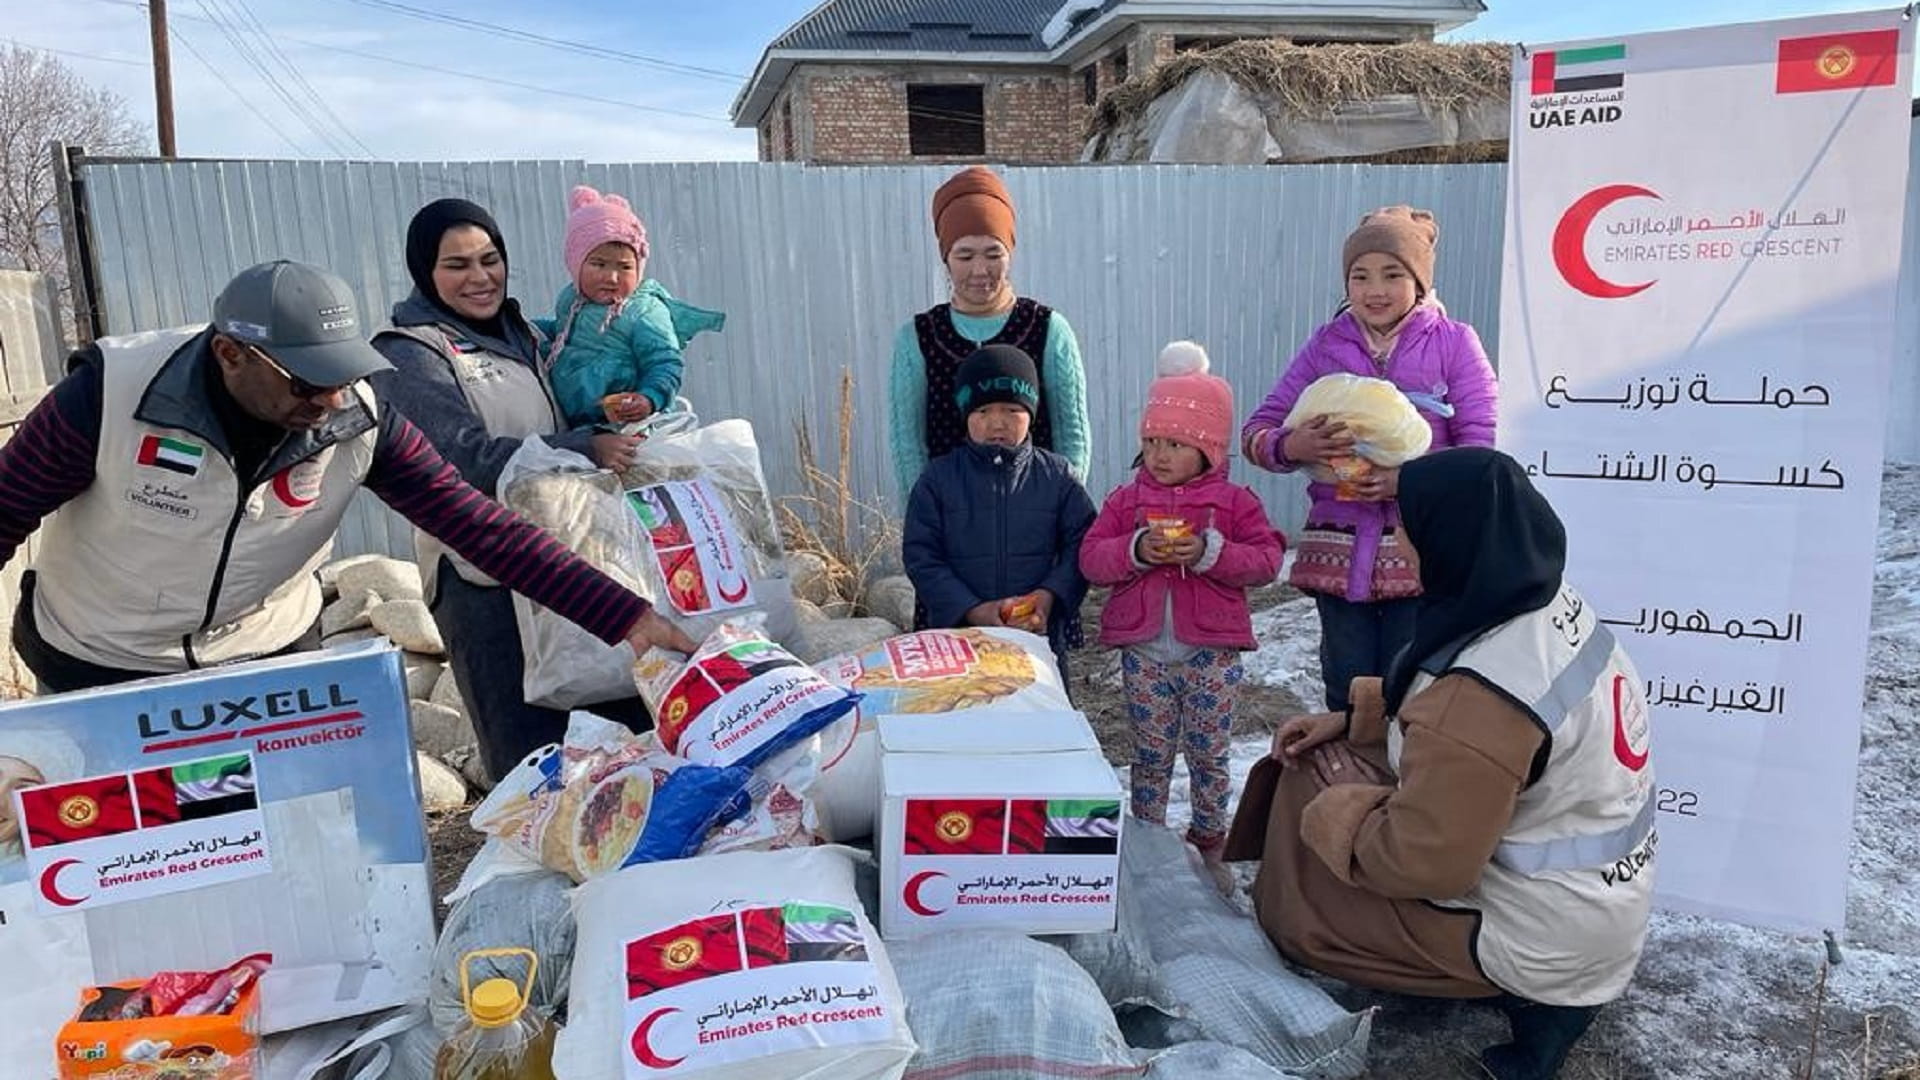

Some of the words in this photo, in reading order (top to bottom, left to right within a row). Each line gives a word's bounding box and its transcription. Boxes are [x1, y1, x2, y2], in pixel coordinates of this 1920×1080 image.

[1529, 109, 1576, 128] UAE
[1579, 105, 1622, 125] AID
[1686, 209, 1764, 235] الأحمر
[1765, 207, 1845, 230] الهلال
[1605, 243, 1690, 262] EMIRATES
[1696, 241, 1734, 260] RED
[1740, 237, 1842, 258] CRESCENT
[1545, 375, 1681, 410] توزيع
[1687, 373, 1830, 409] حملة
[1676, 456, 1844, 490] كسوة
[1599, 608, 1802, 645] الجمهوري
[1645, 676, 1785, 715] القيرغيزي
[137, 684, 359, 740] LUXELL
[714, 717, 765, 751] Emirates
[763, 700, 786, 720] Red
[256, 724, 365, 754] konvektör
[1656, 788, 1699, 817] 22
[207, 830, 262, 853] الهلال
[99, 868, 166, 889] Emirates
[168, 860, 198, 876] Red
[200, 848, 264, 869] Crescent
[1060, 876, 1114, 891] الهلال
[956, 893, 1018, 905] Emirates
[1020, 893, 1048, 903] Red
[1050, 892, 1111, 904] Crescent
[820, 985, 878, 1004] الهلال
[698, 1018, 774, 1046] Emirates
[776, 1011, 808, 1030] Red
[811, 1004, 884, 1024] Crescent
